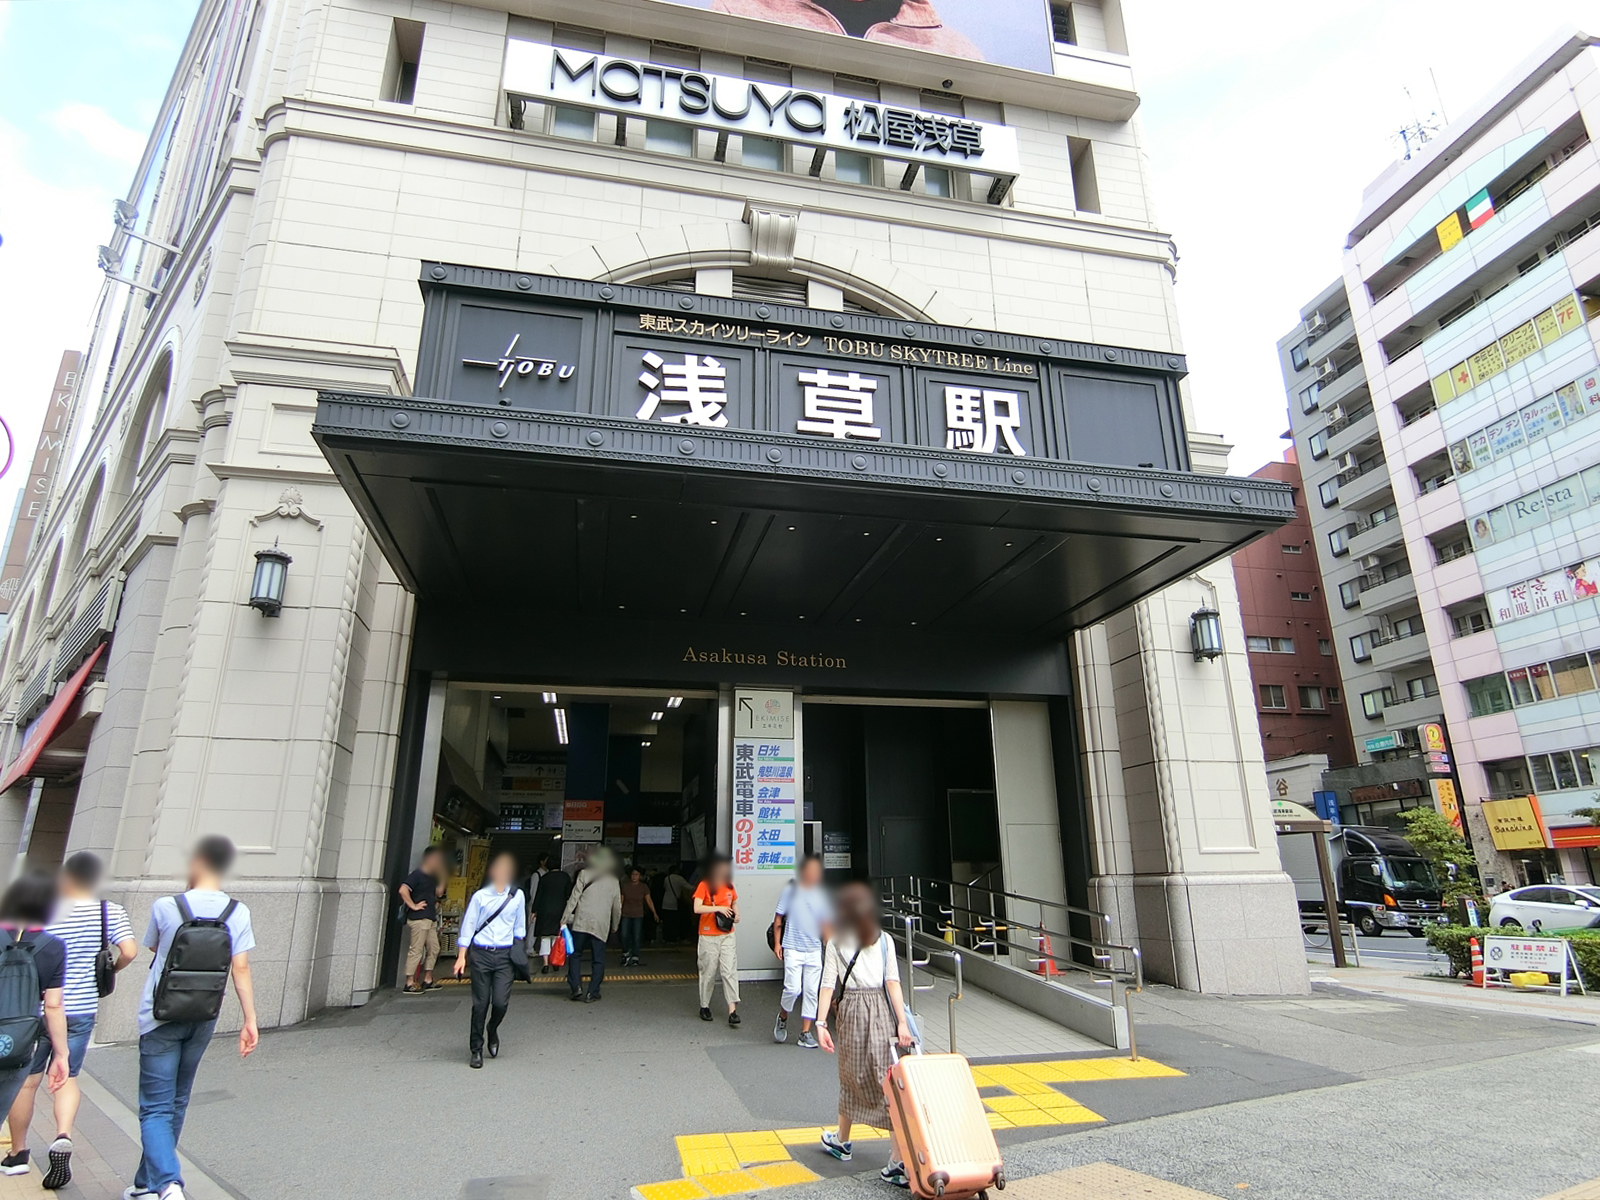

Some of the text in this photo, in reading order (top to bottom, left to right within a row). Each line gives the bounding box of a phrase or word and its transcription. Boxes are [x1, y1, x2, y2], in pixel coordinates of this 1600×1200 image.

[843, 100, 985, 159] 松屋浅草
[1557, 306, 1575, 324] 7F
[639, 313, 1033, 375] 東武スカイツリーライン TOBU SKYTREE Line
[635, 351, 1027, 457] 浅草駅
[28, 371, 77, 517] EKIMISE
[1514, 487, 1573, 519] Re:sta
[682, 647, 848, 669] Asakusa Station
[755, 715, 790, 723] EKIMISE
[757, 744, 780, 757] 日光
[757, 766, 793, 778] 鬼怒川温泉
[757, 786, 780, 799] 会津
[1275, 778, 1289, 796] 谷
[735, 743, 755, 865] 東武電車のりば
[757, 806, 781, 819] 館林
[757, 829, 781, 841] 太田
[757, 851, 781, 864] 赤城
